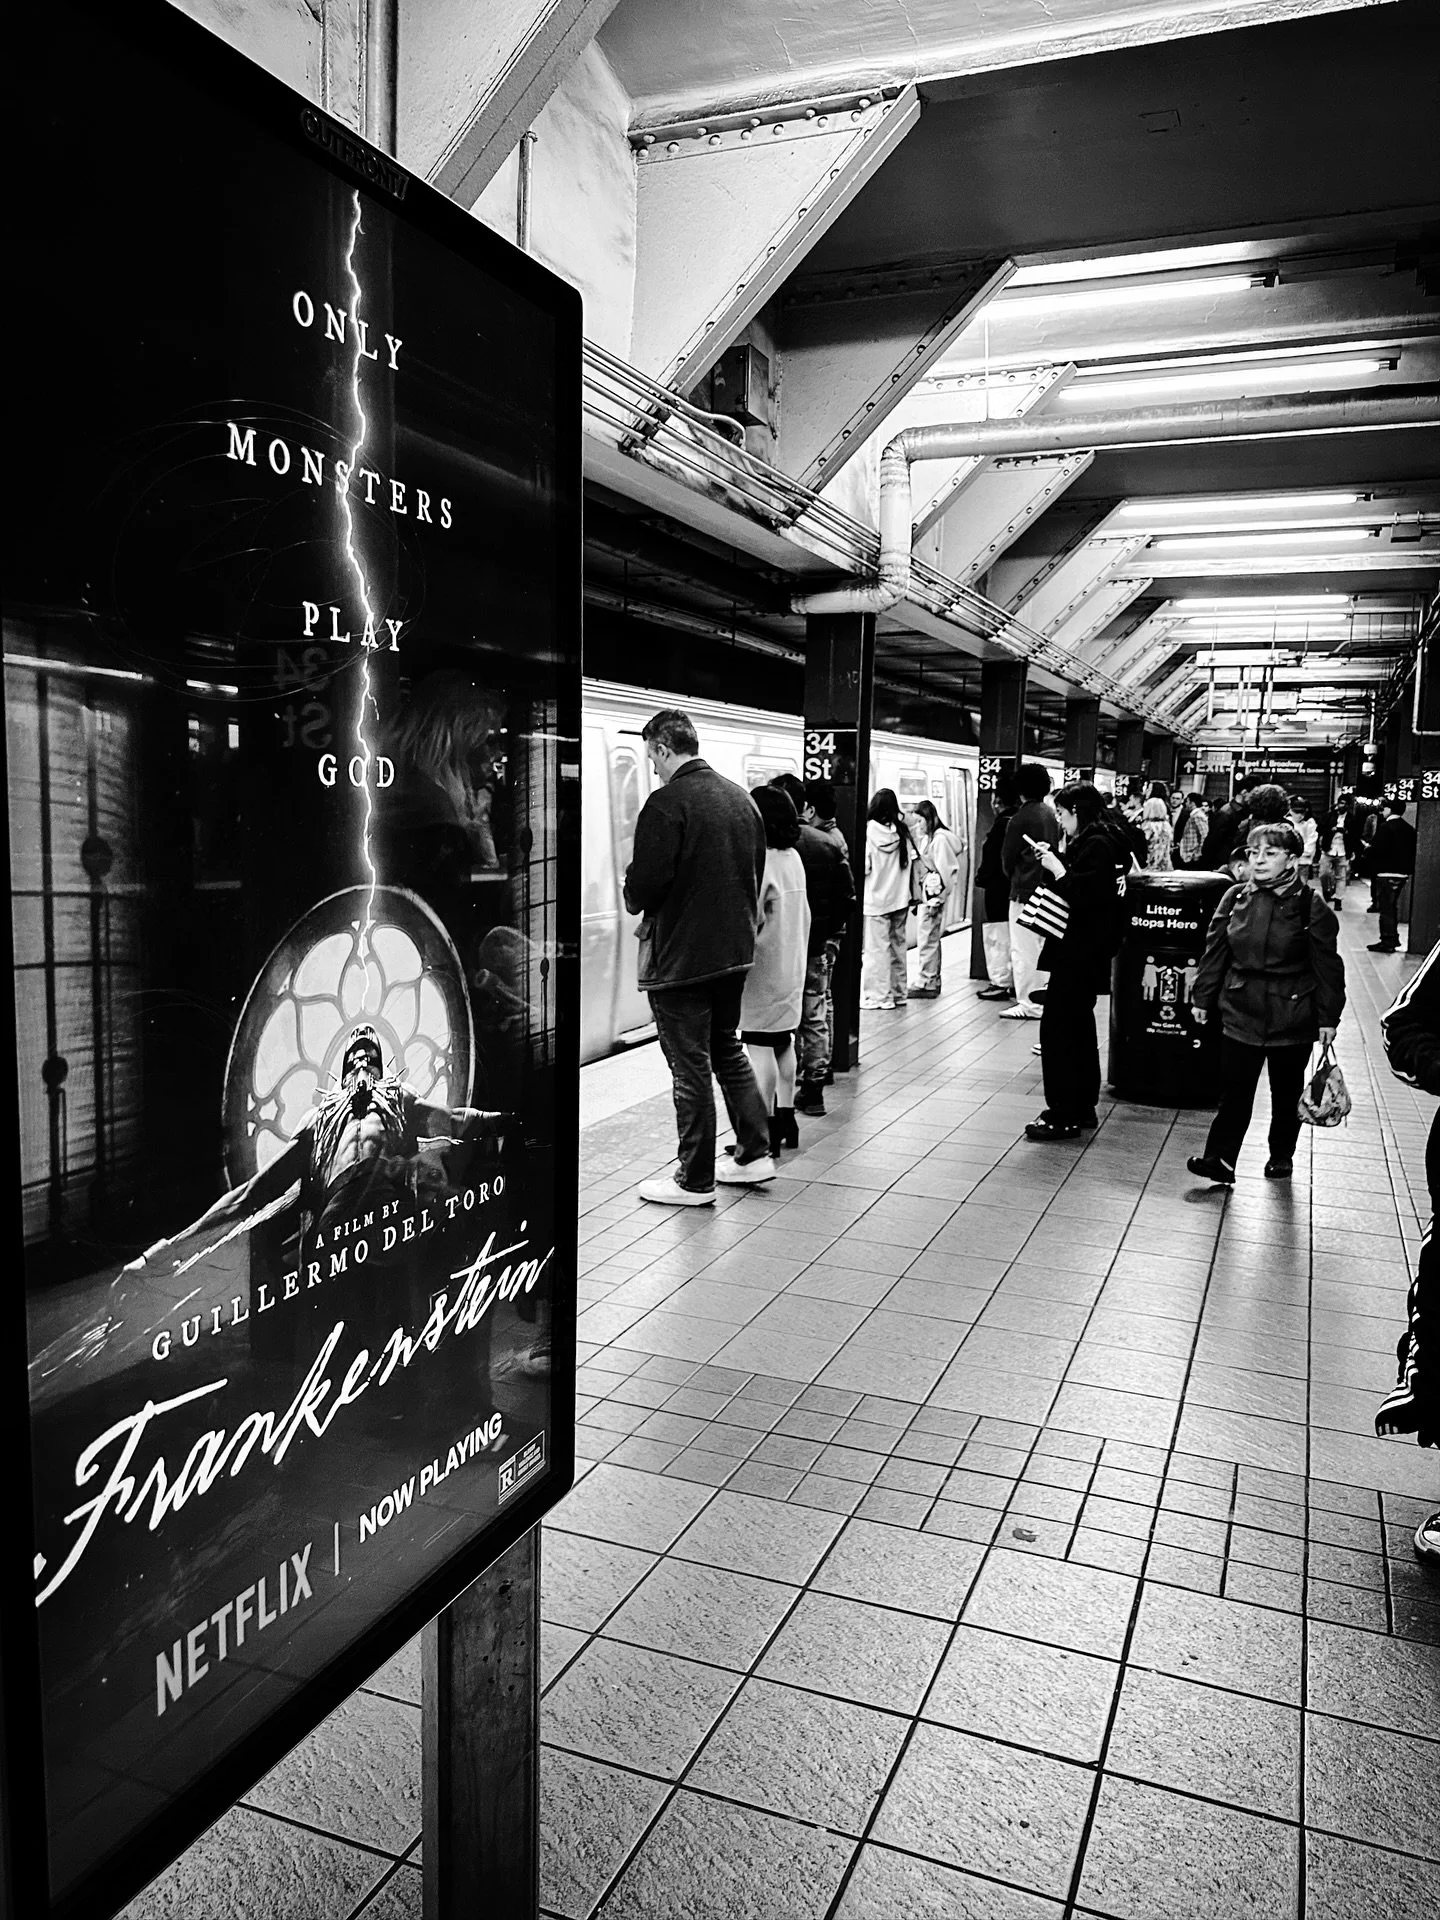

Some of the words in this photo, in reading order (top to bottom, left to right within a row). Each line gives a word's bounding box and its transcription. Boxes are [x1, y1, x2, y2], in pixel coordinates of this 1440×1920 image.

[292, 290, 403, 370] ONLY
[226, 422, 453, 528] MONSTERS
[302, 601, 403, 652] PLAY
[805, 732, 837, 755] 34
[317, 753, 395, 788] GOD
[804, 757, 832, 780] St
[980, 758, 1002, 773] 34
[1064, 769, 1081, 781] 34
[979, 774, 999, 790] St
[1115, 776, 1130, 786] 34
[1399, 779, 1415, 790] 34
[1422, 771, 1440, 785] 34
[1383, 783, 1398, 793] 34
[1398, 790, 1412, 801] St
[1421, 785, 1439, 798] St
[1146, 904, 1182, 916] Litter
[1131, 916, 1164, 929] Stops
[1166, 919, 1198, 930] Here
[314, 1232, 325, 1249] A
[332, 1214, 375, 1241] FILM
[382, 1199, 400, 1220] BY
[152, 1240, 369, 1361] GUILLERMO
[382, 1208, 435, 1252] DEL
[444, 1175, 505, 1220] TORO
[34, 1220, 555, 1608] Frankenstein
[500, 1467, 515, 1494] R
[155, 1541, 313, 1717] NETFLIX
[358, 1475, 416, 1543] NOW
[418, 1411, 503, 1496] PLAYING
